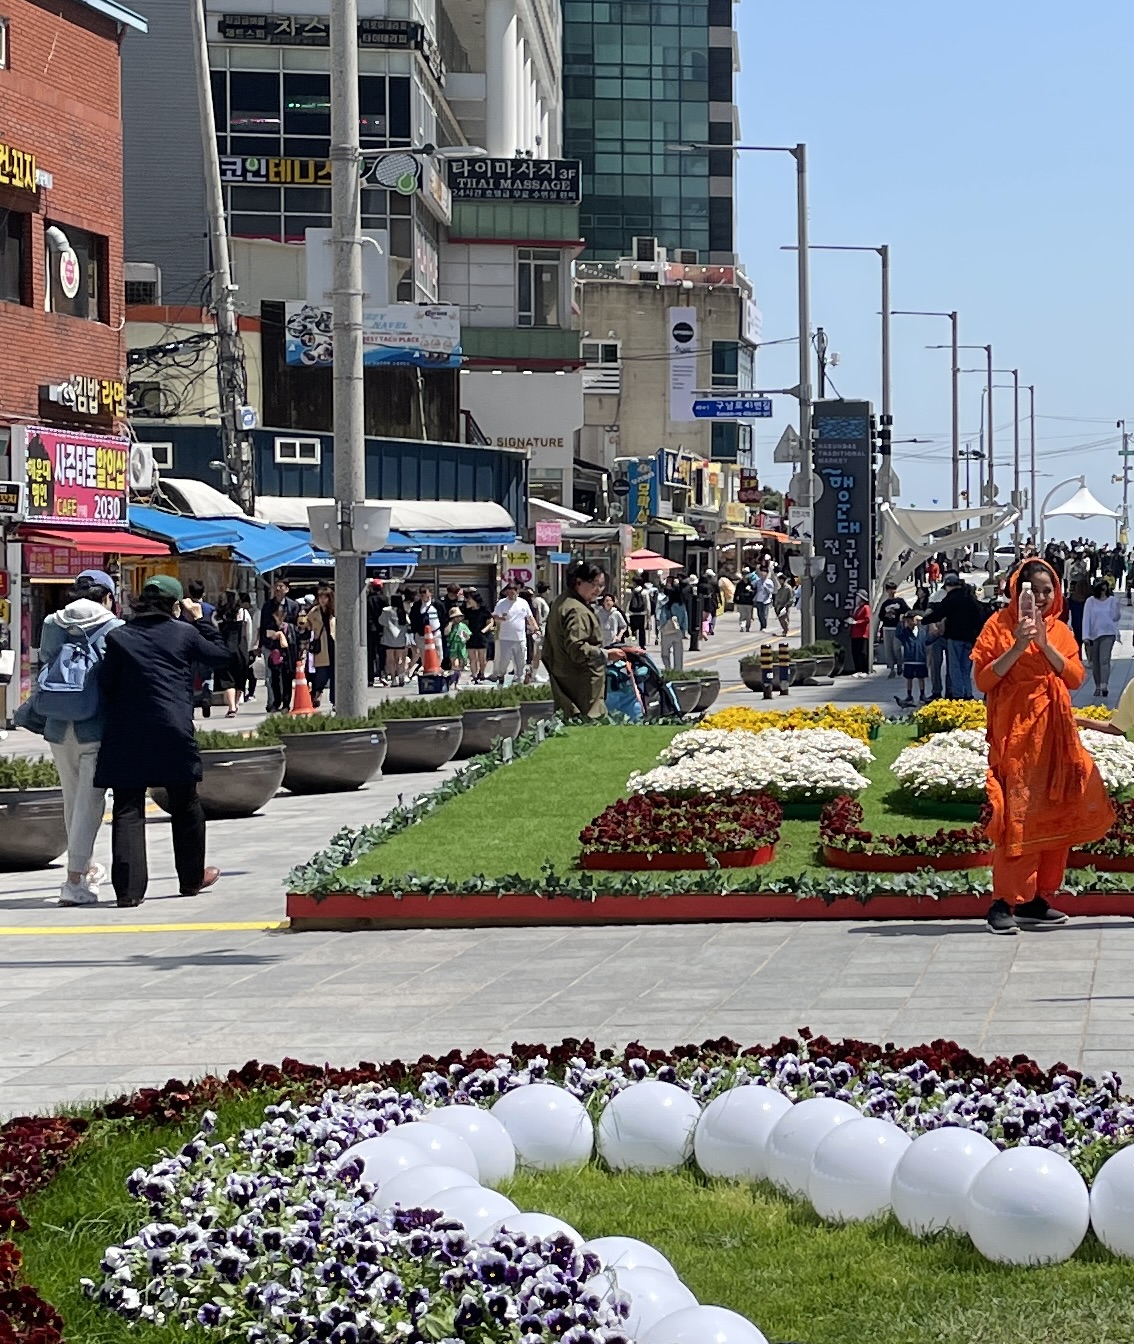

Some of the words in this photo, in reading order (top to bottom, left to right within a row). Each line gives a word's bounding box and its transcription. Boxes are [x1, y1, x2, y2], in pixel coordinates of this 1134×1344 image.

[451, 159, 556, 179] 타이마사지
[559, 169, 576, 179] 3F
[457, 178, 494, 189] THAI
[500, 179, 571, 191] MASSAGE
[75, 375, 99, 415] 김밥
[497, 437, 564, 448] SIGNATURE
[56, 499, 77, 517] CAFE
[94, 495, 120, 519] 2030
[823, 539, 840, 635] 전통시장
